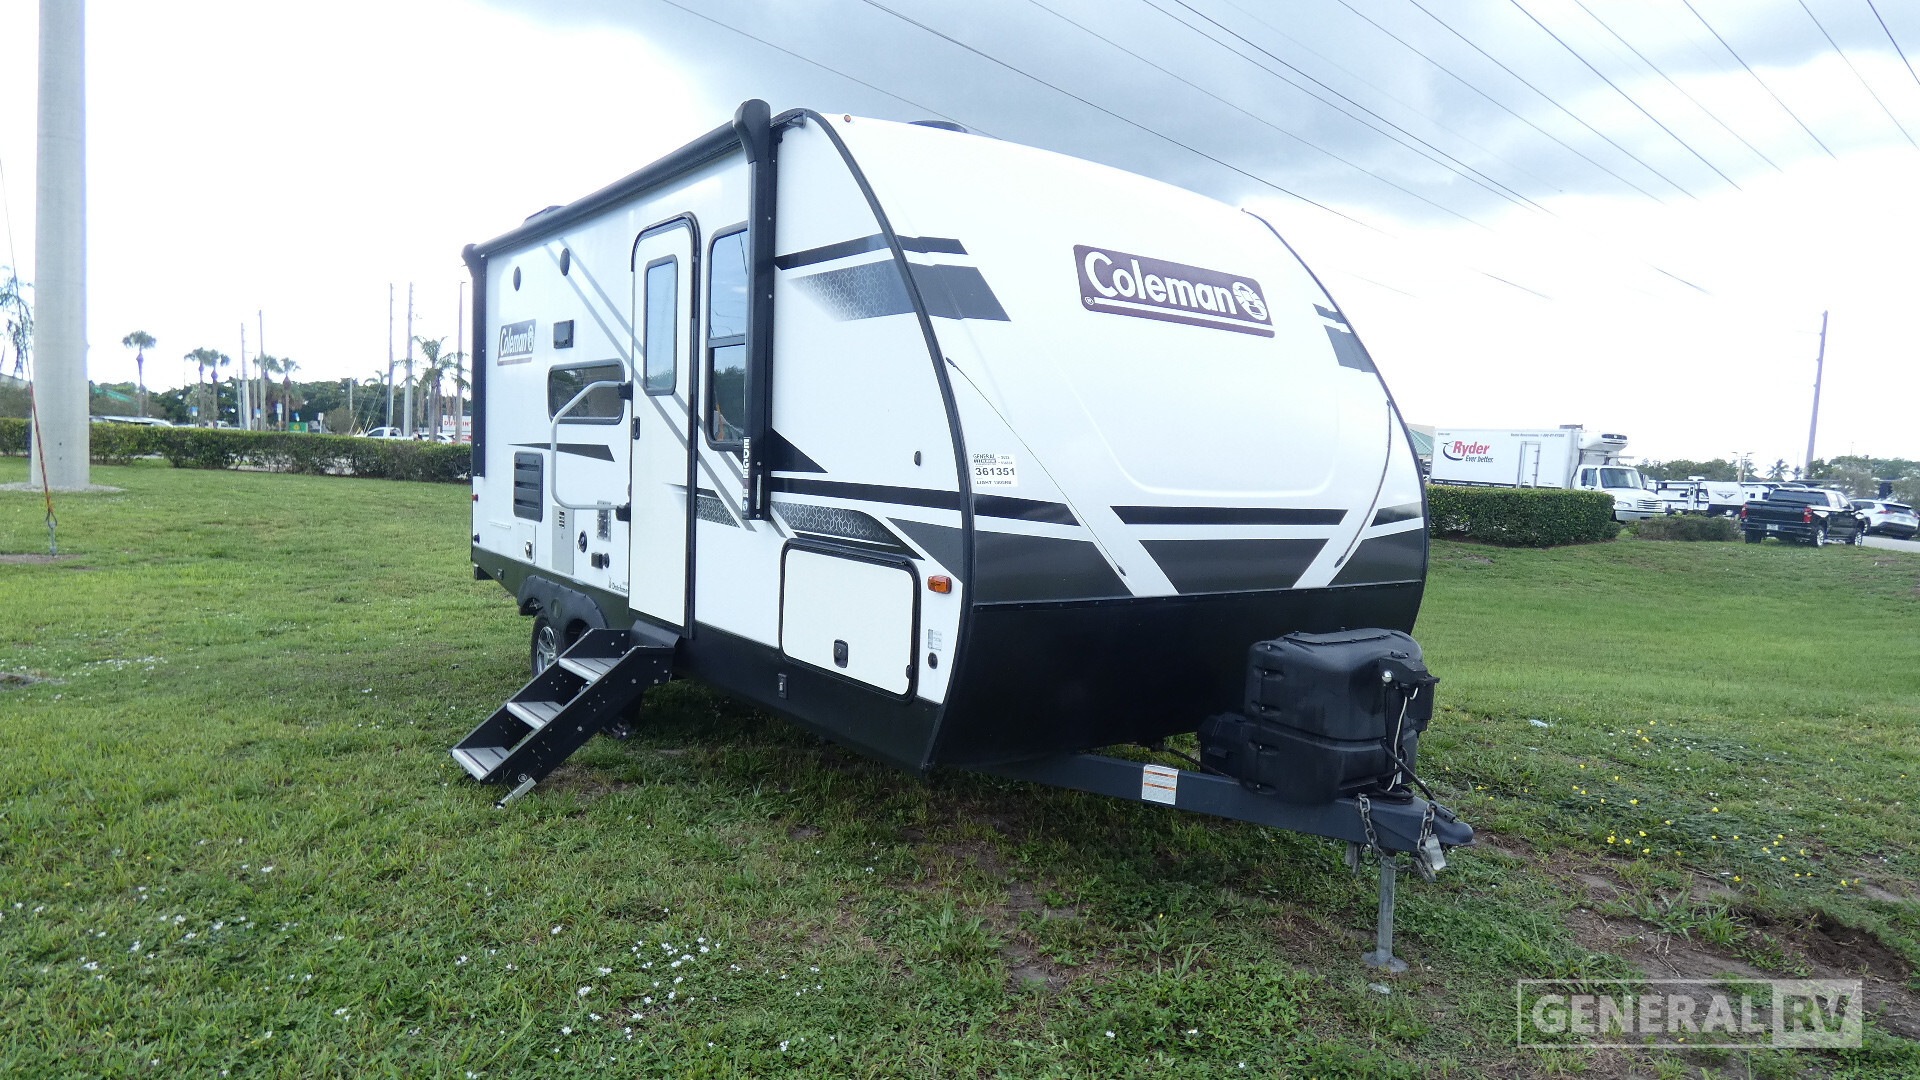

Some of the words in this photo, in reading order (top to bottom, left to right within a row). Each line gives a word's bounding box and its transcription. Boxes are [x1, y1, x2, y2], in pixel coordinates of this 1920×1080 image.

[1084, 251, 1238, 315] Coleman
[500, 327, 527, 356] Coleman
[1453, 440, 1490, 457] Ryder
[975, 467, 1015, 476] 361351
